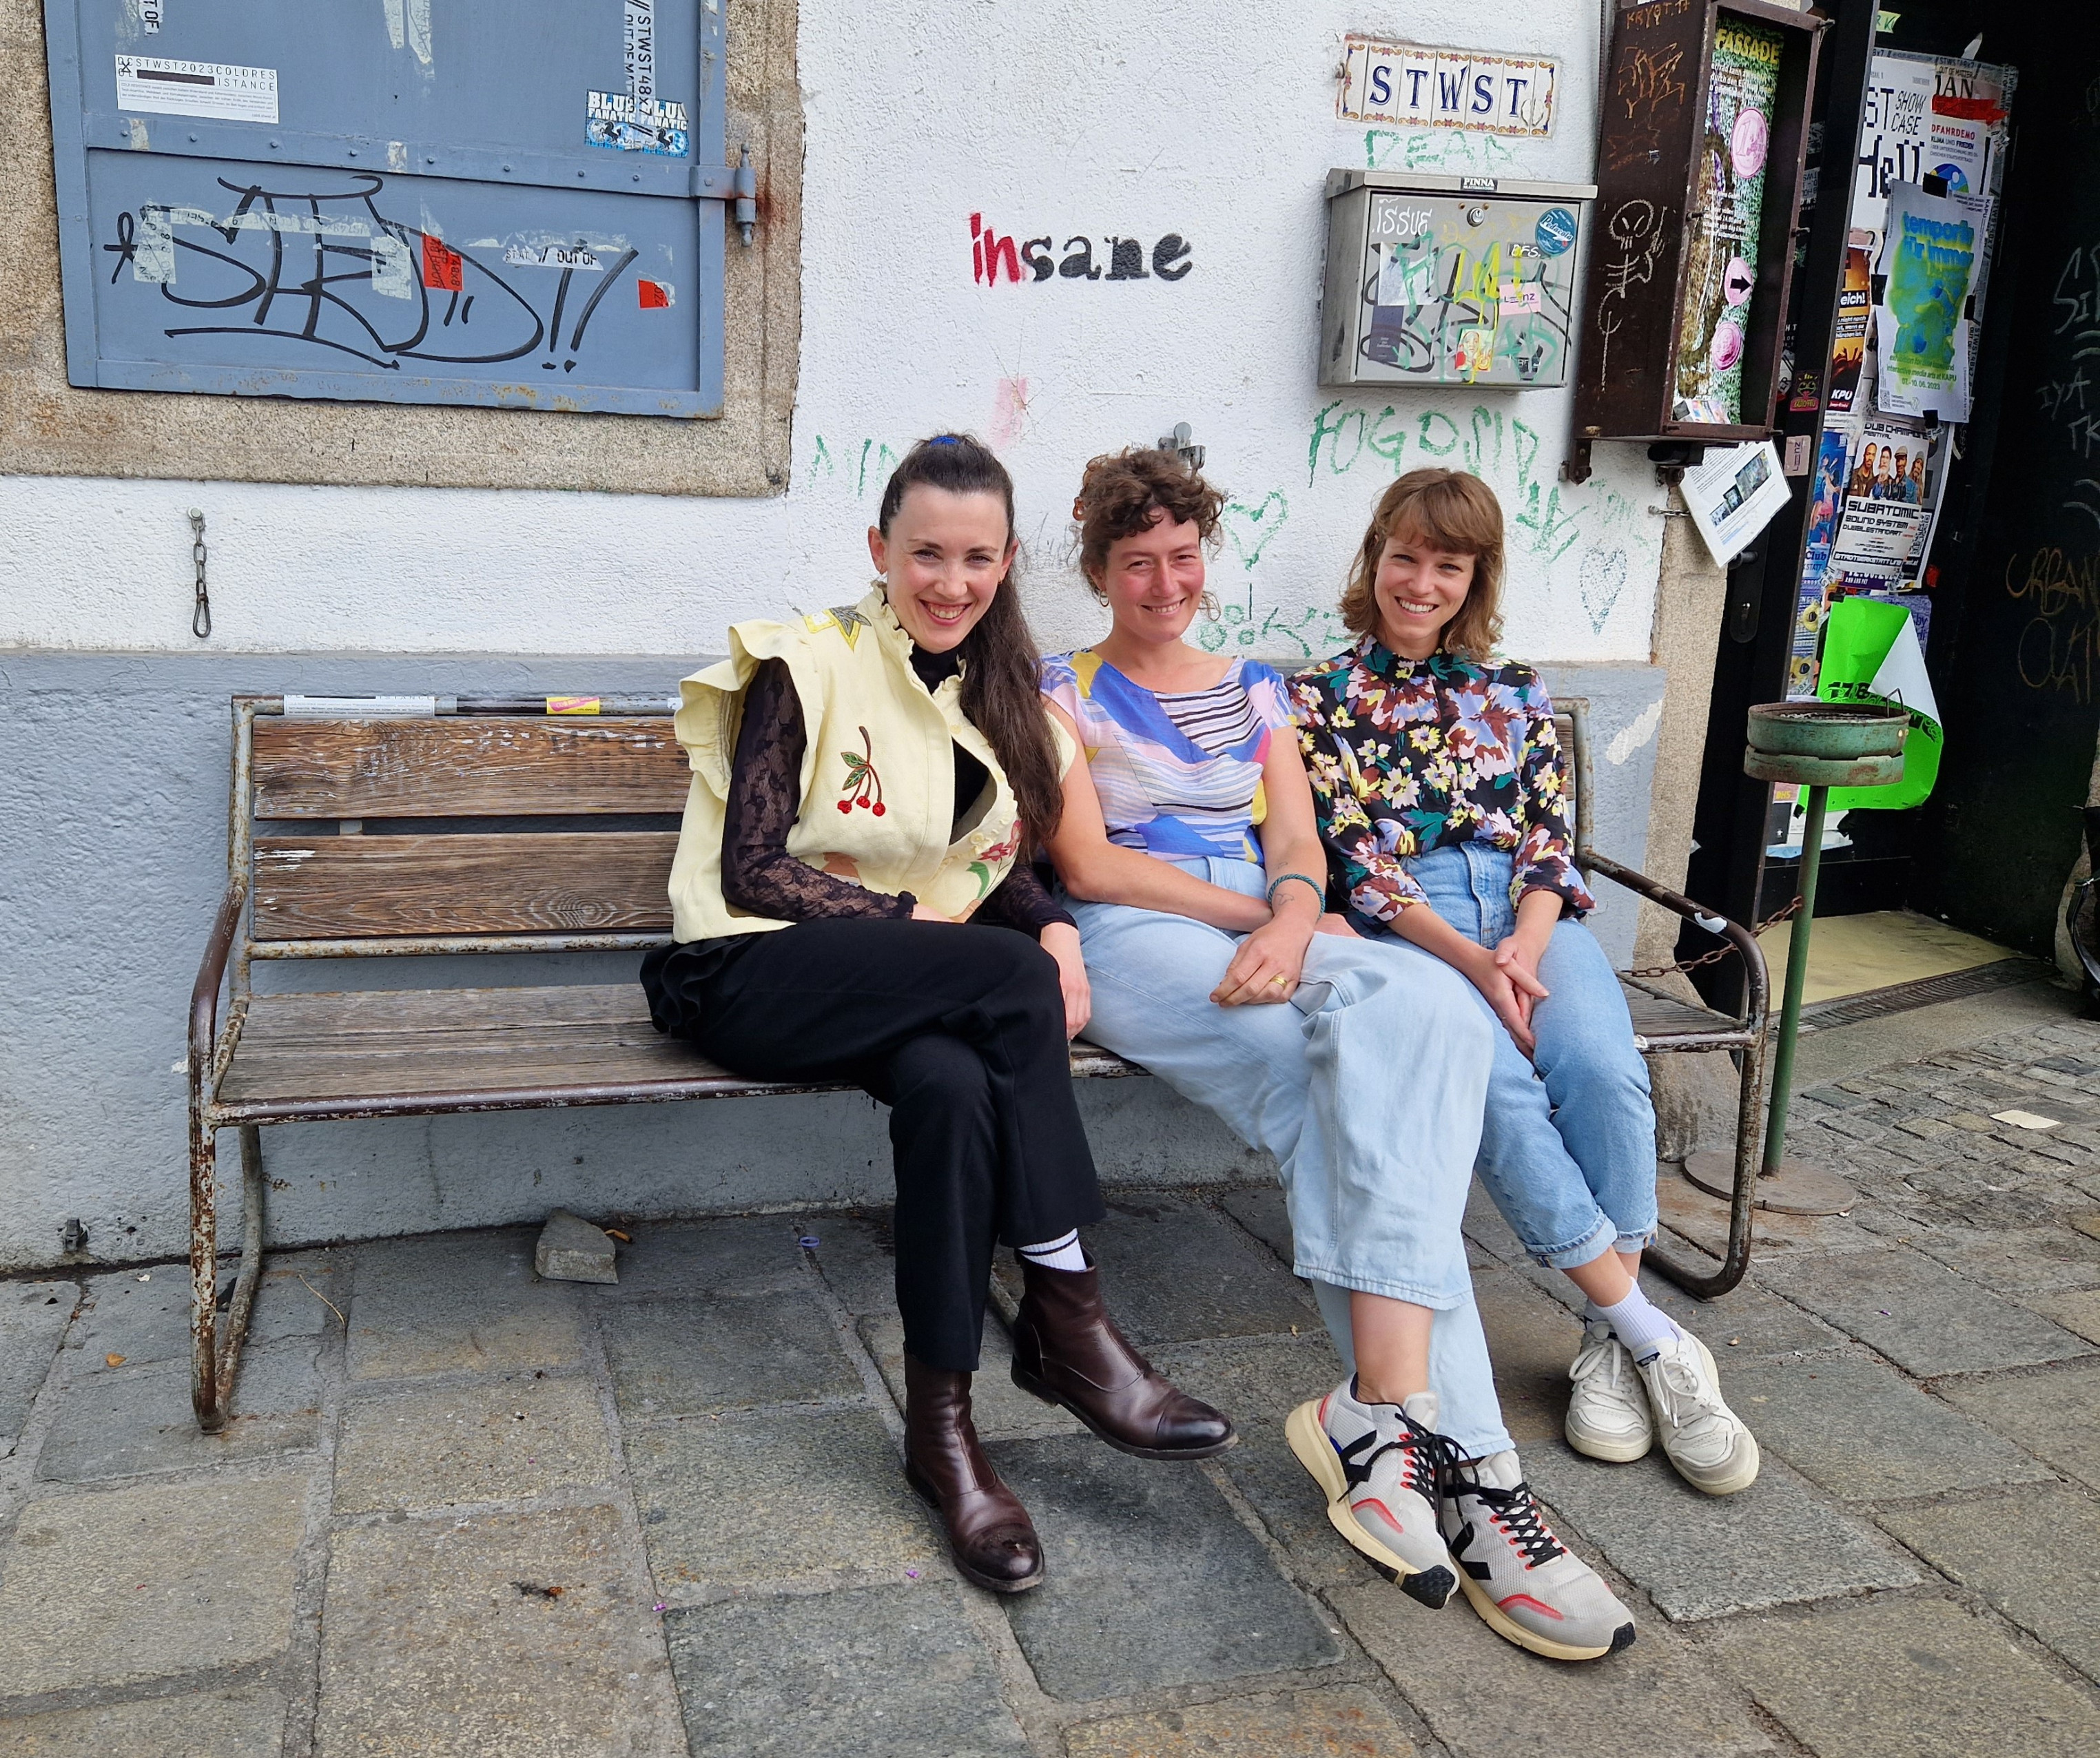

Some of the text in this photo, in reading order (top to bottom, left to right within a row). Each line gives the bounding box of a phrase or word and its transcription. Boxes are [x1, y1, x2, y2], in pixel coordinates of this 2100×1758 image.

[1716, 28, 1780, 64] FASSADE
[218, 77, 275, 91] ISTANCE
[1369, 65, 1528, 118] STWST
[1895, 90, 1927, 114] SHOW
[588, 107, 688, 130] FANATIC FANATIC
[1891, 112, 1922, 136] CASE
[1931, 136, 1945, 144] KLIMA
[1463, 177, 1495, 187] PINNA
[1982, 198, 1991, 218] KAPU
[1540, 214, 1574, 241] Pedacola
[1942, 373, 1957, 382] KAPU
[1864, 422, 1884, 431] DUB
[1863, 431, 1892, 440] FESTIVAL
[1847, 500, 1920, 519] SUBATOMIC
[1845, 515, 1875, 525] SOUND
[1876, 518, 1908, 530] SYSTEM
[1842, 524, 1903, 537] DUBBLESTANDART
[1806, 550, 1826, 561] Club
